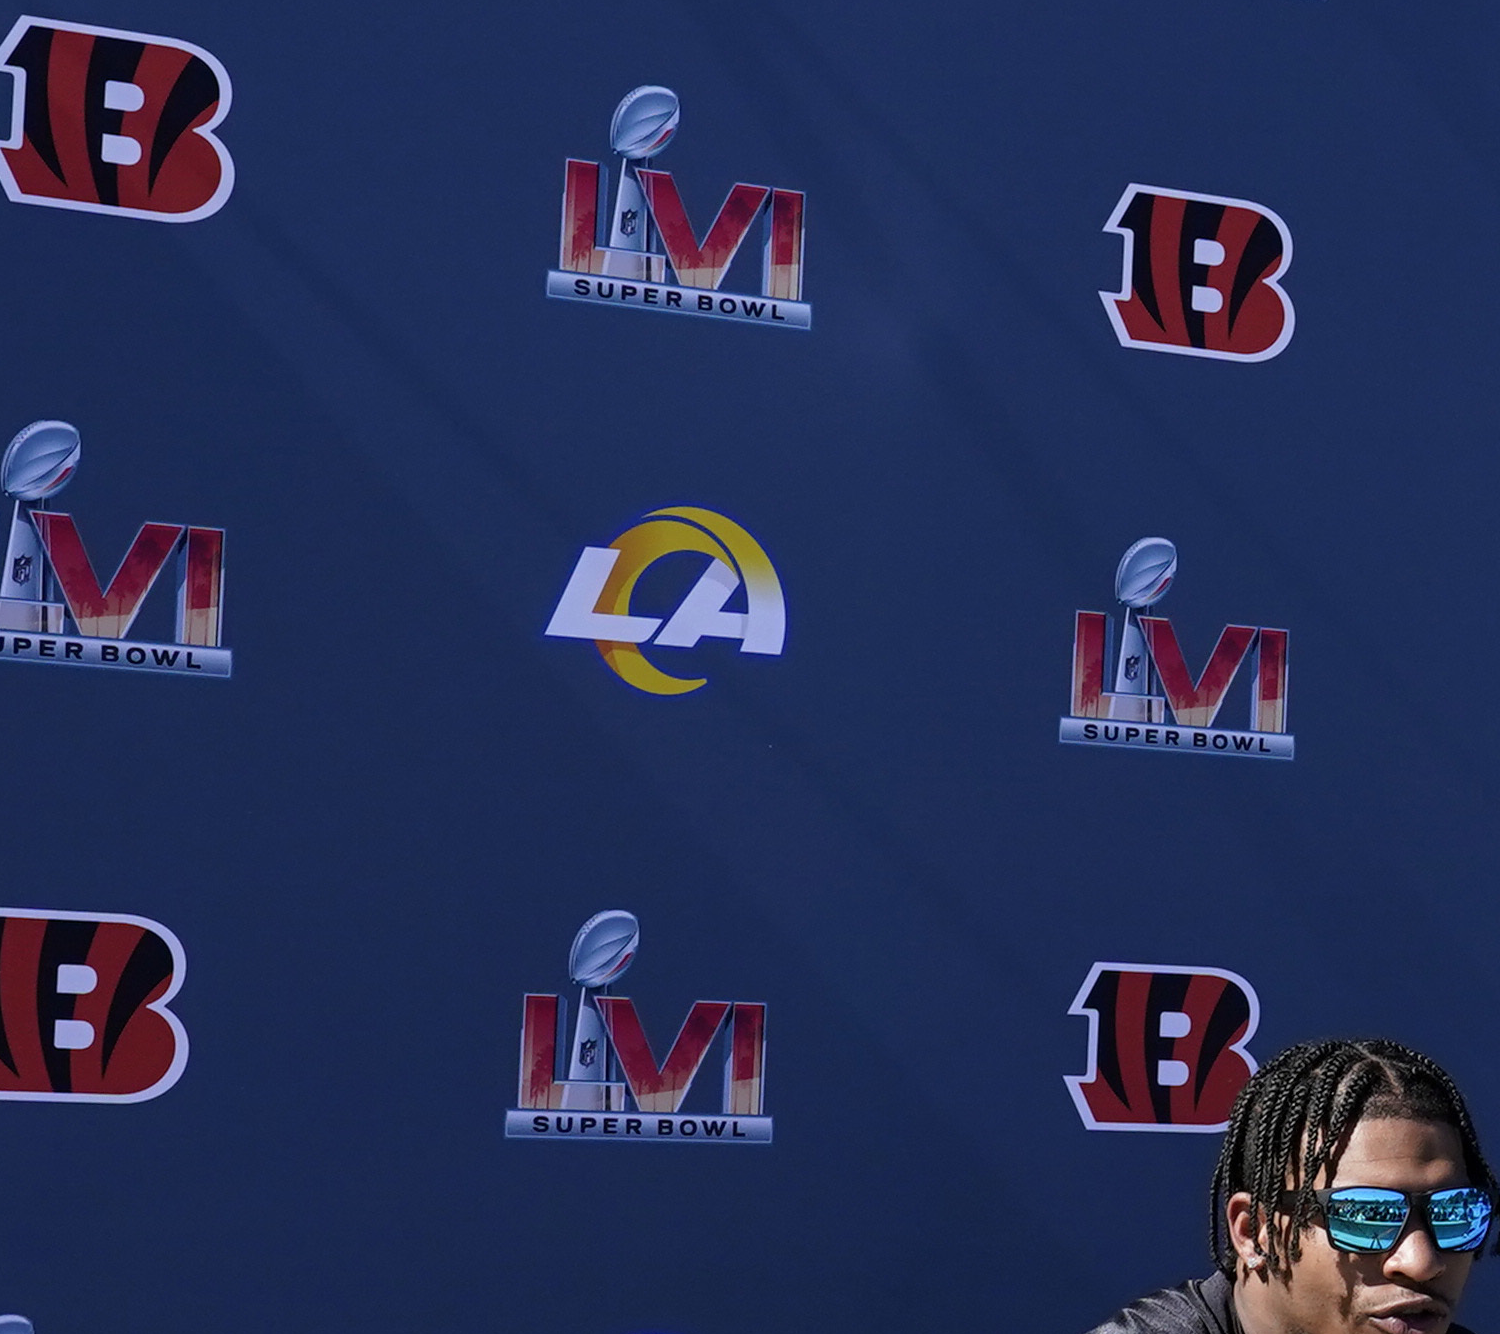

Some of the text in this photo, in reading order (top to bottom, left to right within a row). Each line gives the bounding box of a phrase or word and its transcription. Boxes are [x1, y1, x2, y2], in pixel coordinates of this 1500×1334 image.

[560, 158, 804, 300] LVI
[1098, 183, 1296, 363] B
[573, 277, 786, 321] SUPER BOWL
[544, 507, 784, 655] LA
[100, 643, 203, 669] BOWL
[1071, 611, 1288, 732] LVI
[1082, 723, 1272, 753] SUPER BOWL
[518, 994, 765, 1114] LVI
[1063, 962, 1262, 1133] B
[532, 1115, 747, 1137] SUPER BOWL
